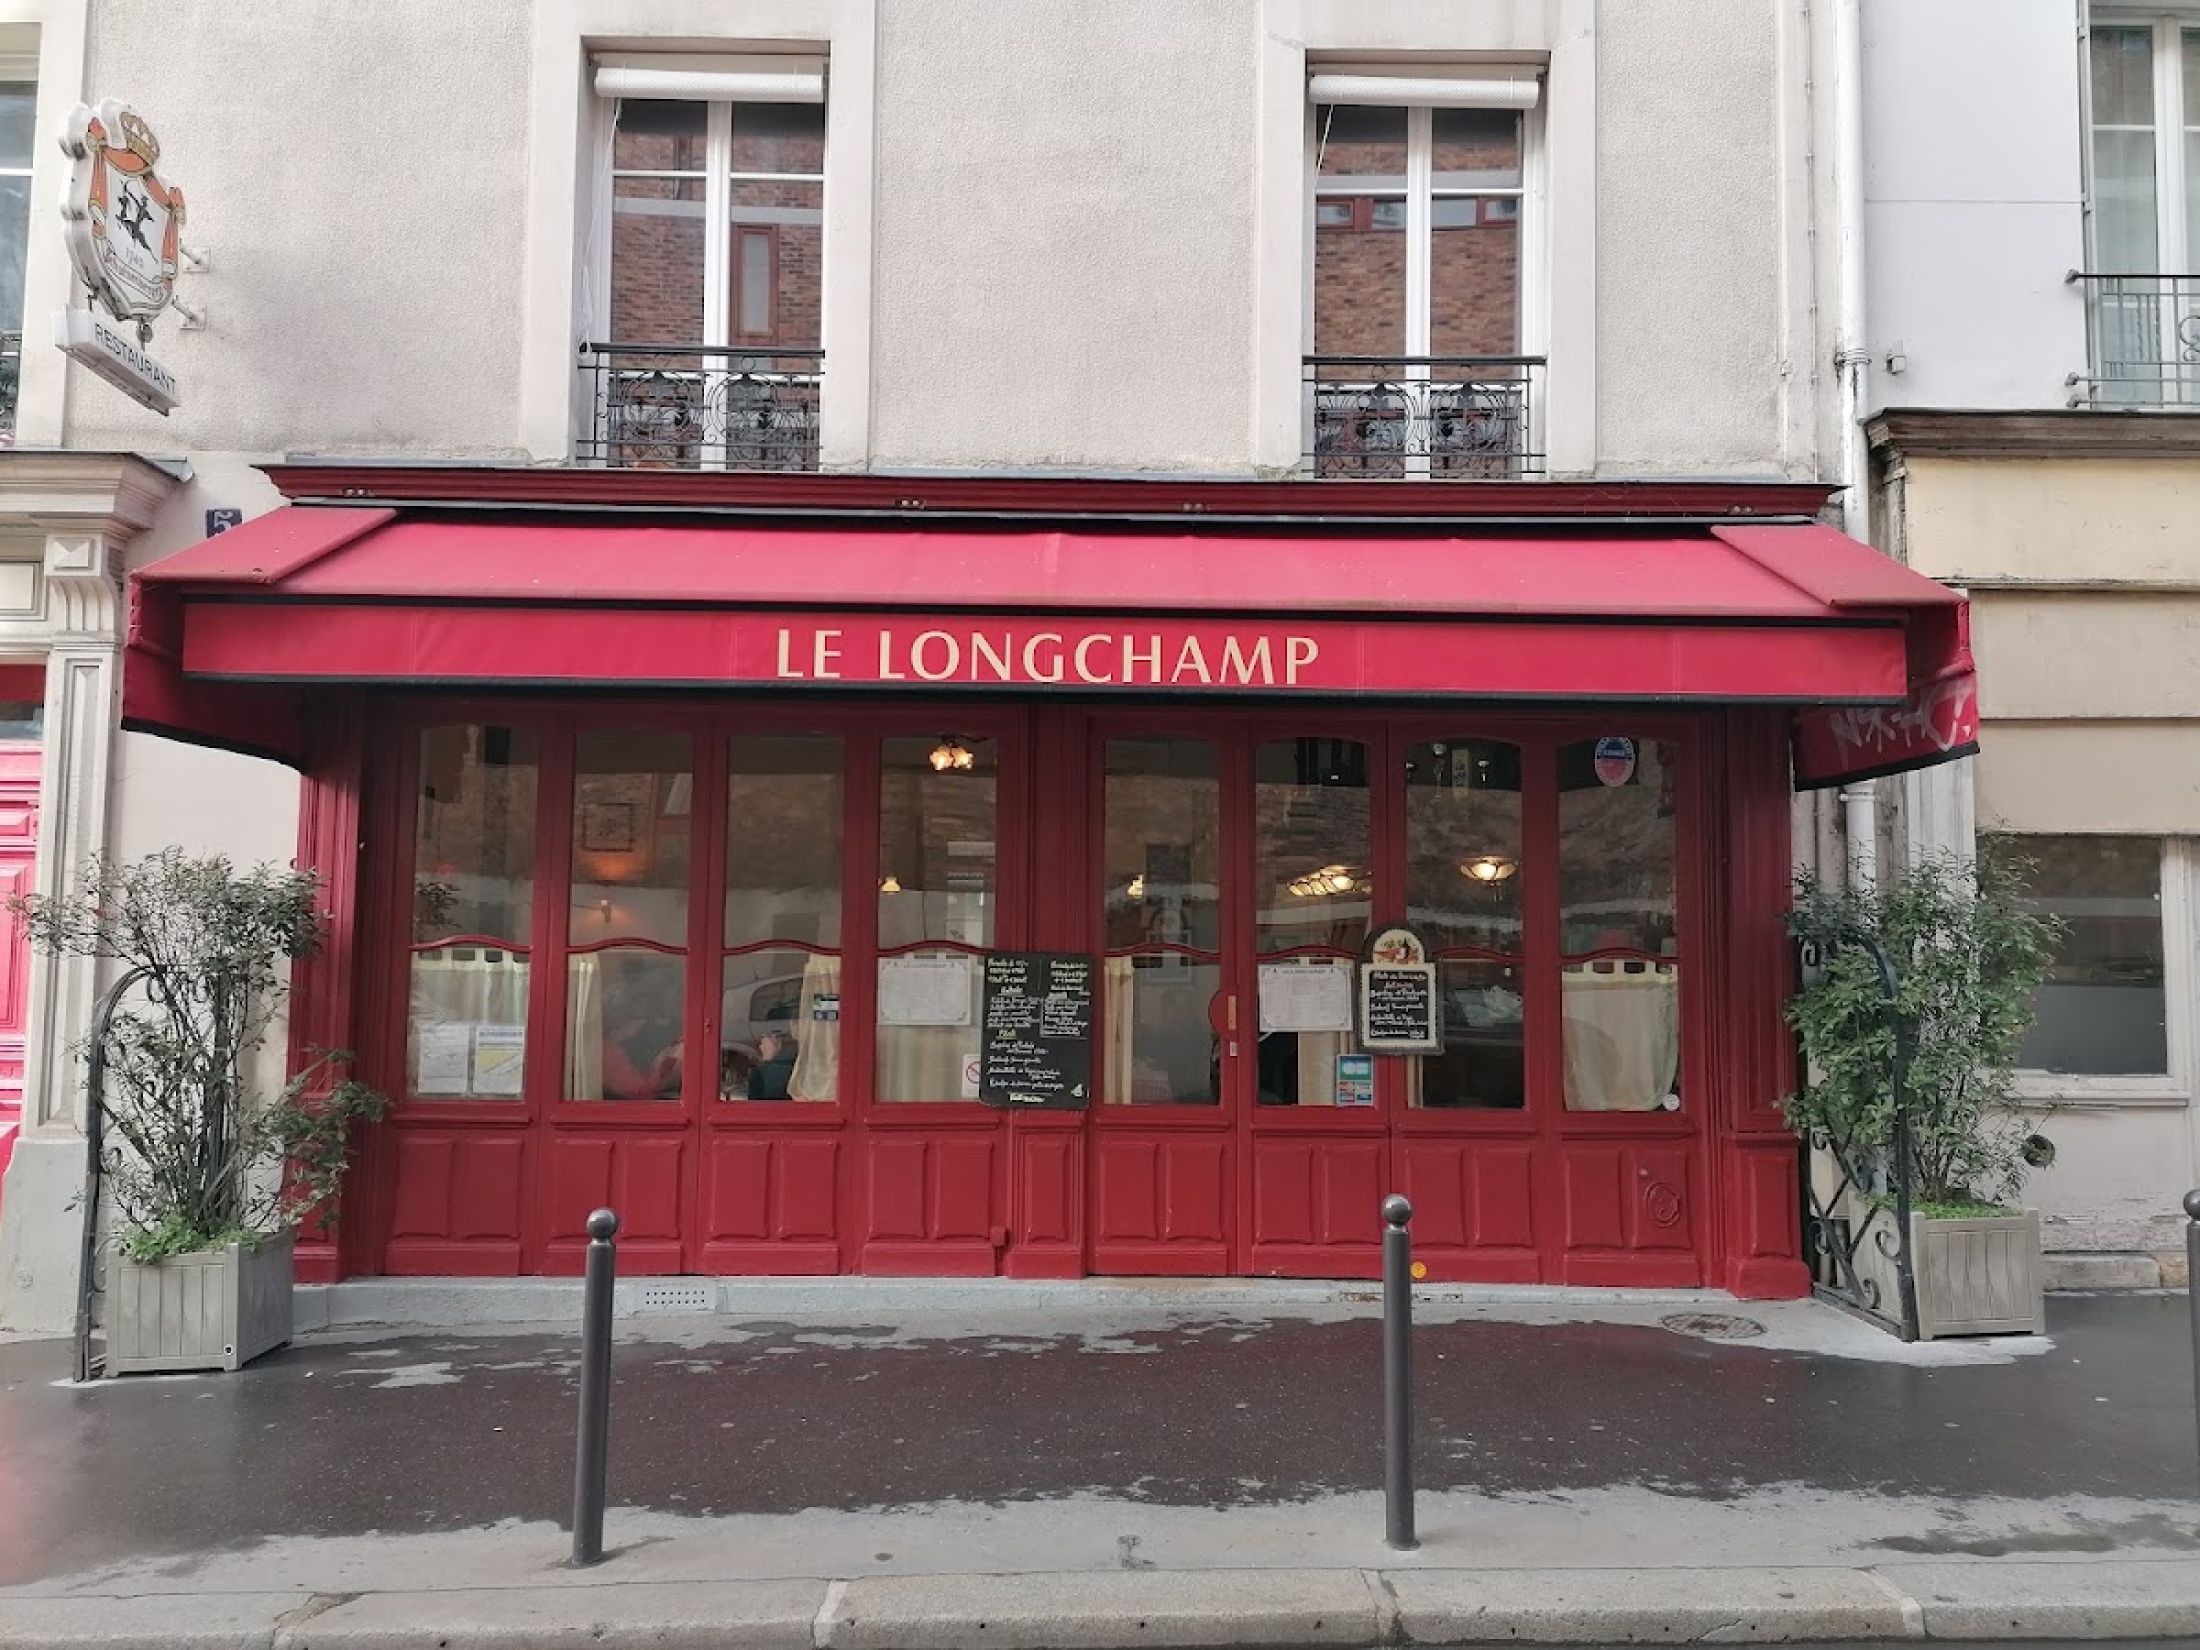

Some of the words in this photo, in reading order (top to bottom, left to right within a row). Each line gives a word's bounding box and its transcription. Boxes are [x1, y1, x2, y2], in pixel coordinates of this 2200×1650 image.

[95, 322, 176, 395] RESTAURANT
[777, 628, 842, 678] LE
[879, 630, 1319, 685] LONGCHAMP
